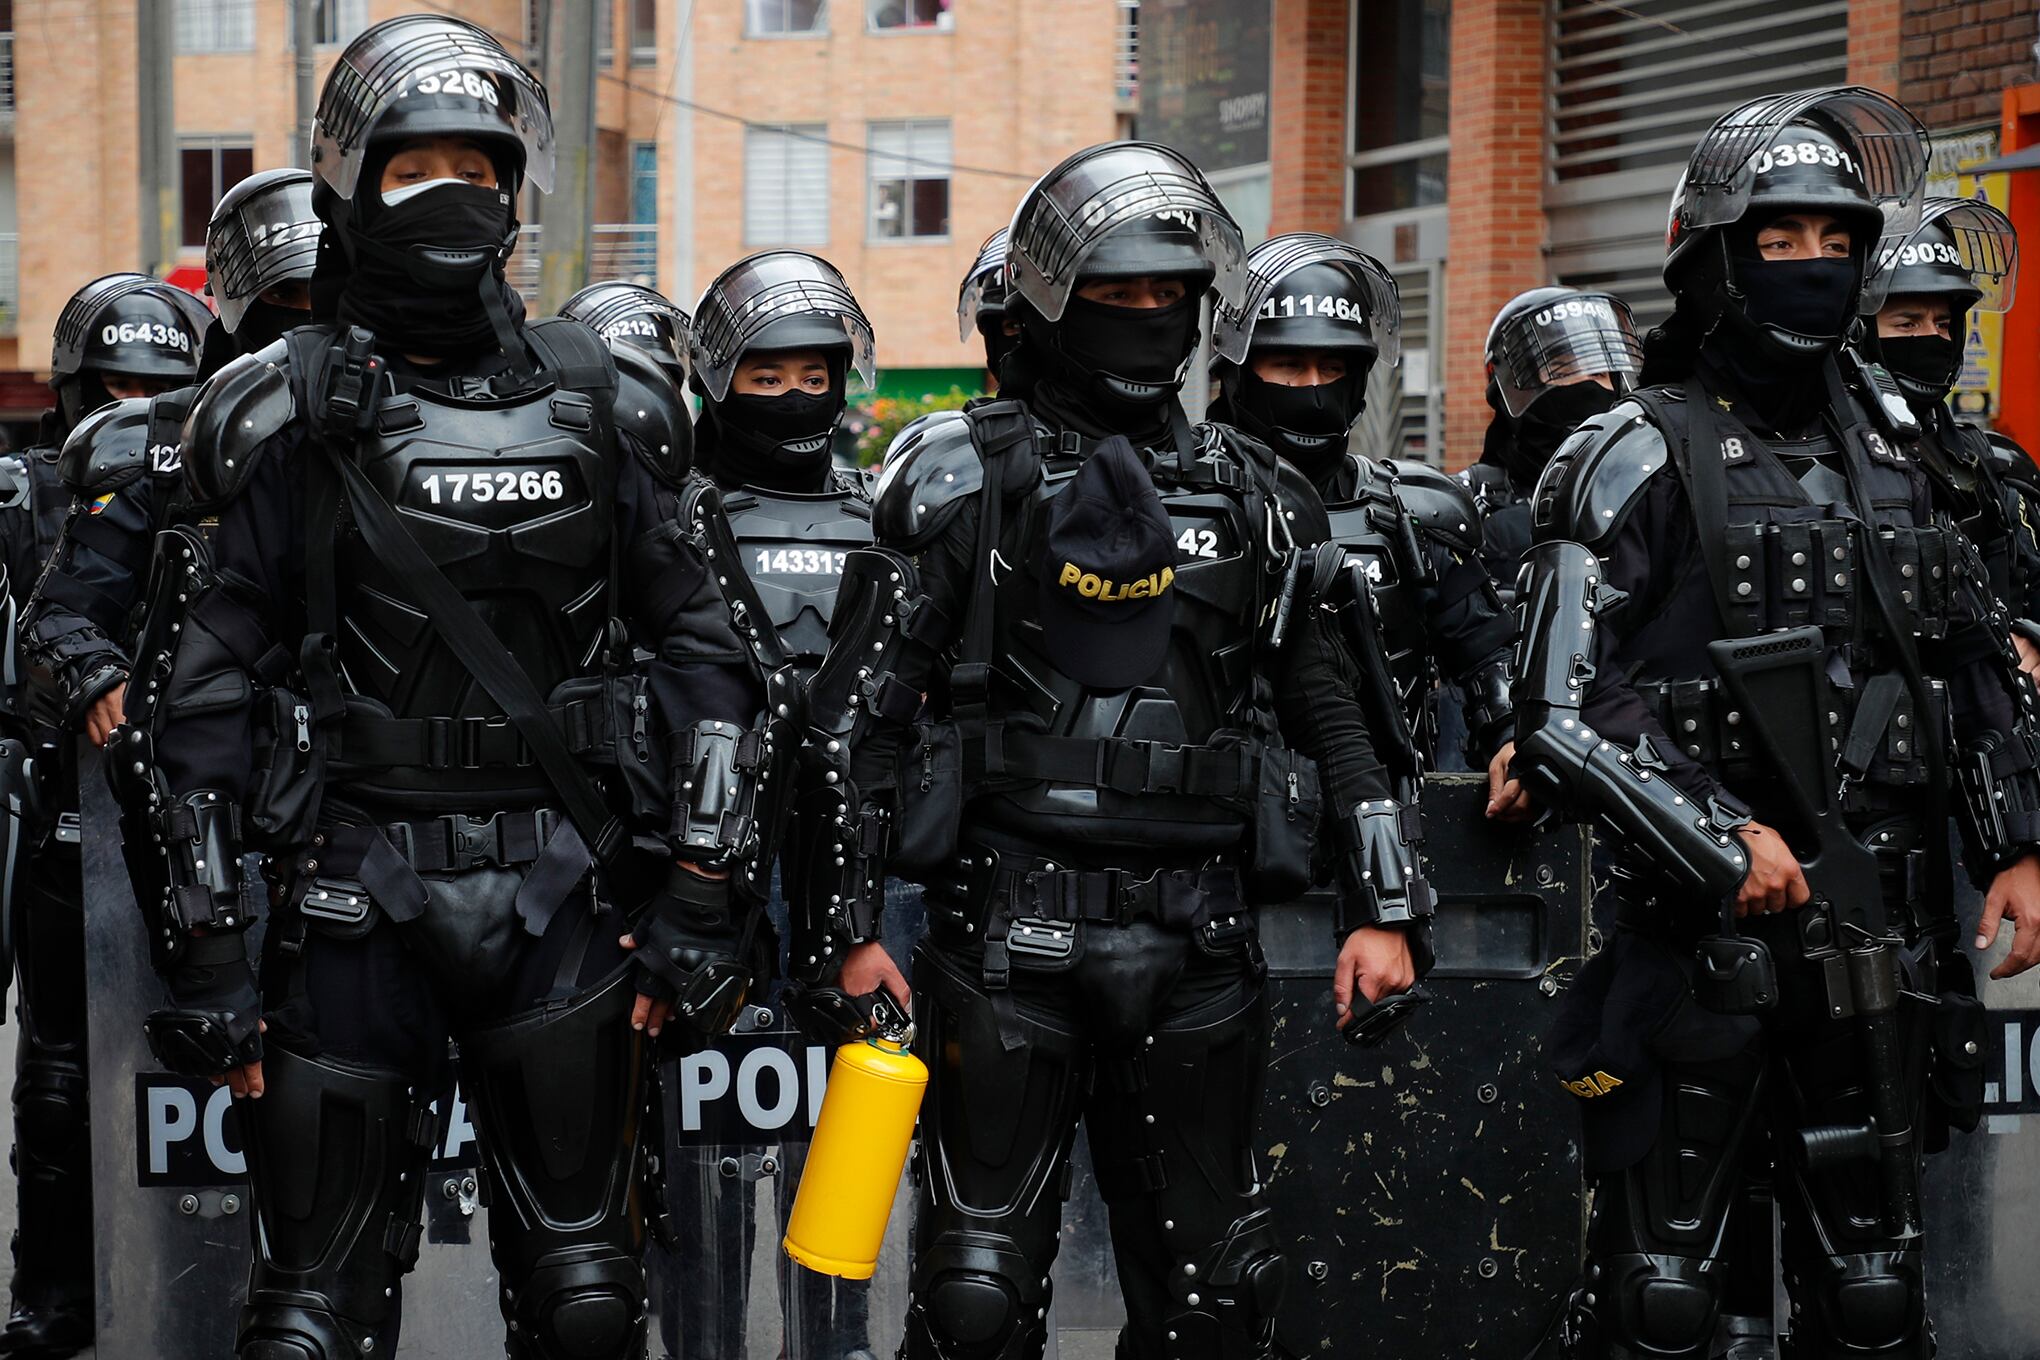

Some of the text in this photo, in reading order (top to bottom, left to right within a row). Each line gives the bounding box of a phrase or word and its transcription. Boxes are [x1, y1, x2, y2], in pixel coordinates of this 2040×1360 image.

[1262, 294, 1362, 325] 111464
[102, 323, 190, 352] 064399
[422, 470, 564, 504] 175266
[1174, 528, 1218, 559] 42
[756, 549, 847, 575] 143313
[1058, 561, 1175, 602] POLICIA
